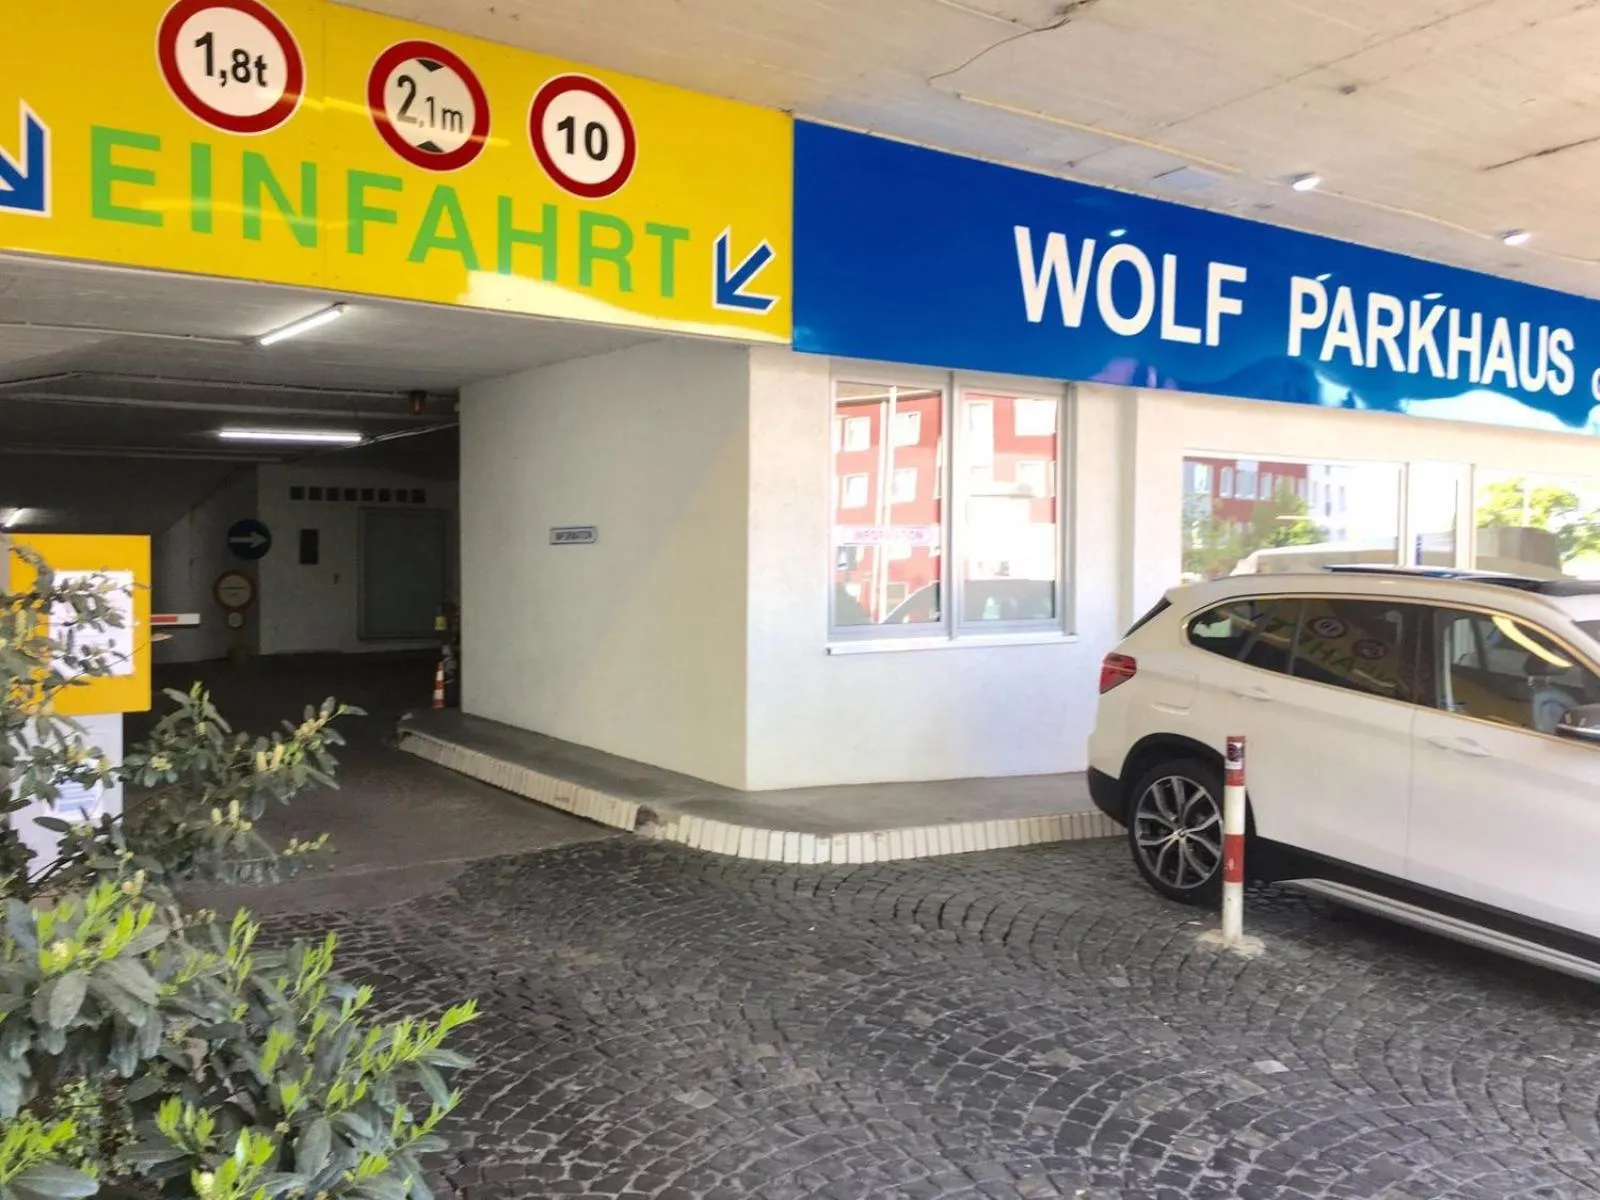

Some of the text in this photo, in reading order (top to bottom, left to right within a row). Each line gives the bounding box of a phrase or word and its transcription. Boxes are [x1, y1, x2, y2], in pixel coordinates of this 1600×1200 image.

[194, 30, 268, 89] 1,8t
[556, 115, 609, 162] 10
[90, 125, 690, 299] EINFAHRT
[1014, 225, 1575, 396] WOLF PARKHAUS
